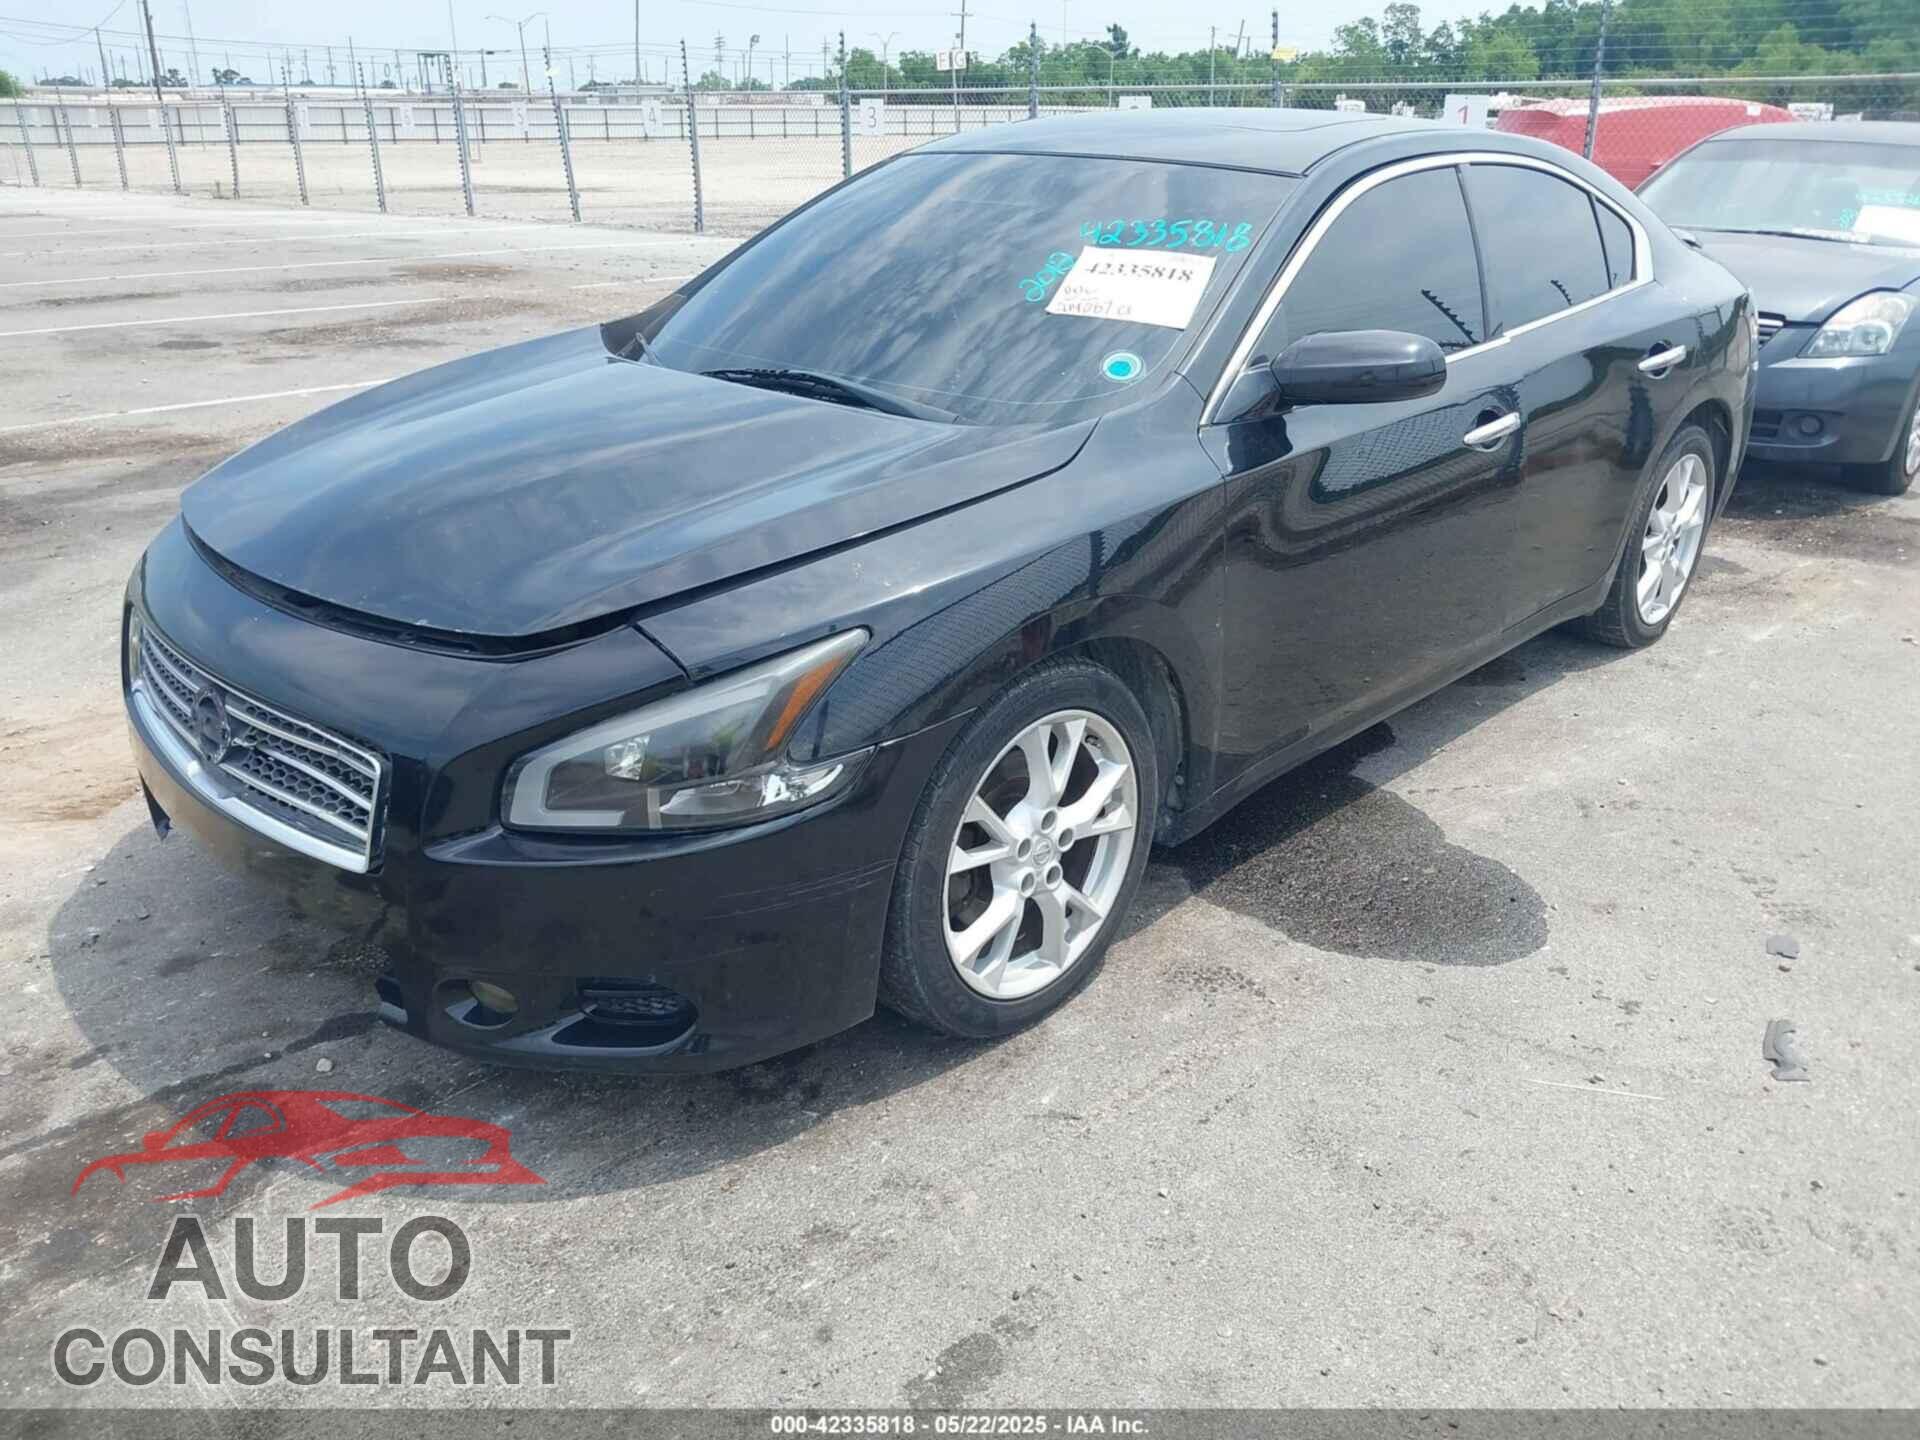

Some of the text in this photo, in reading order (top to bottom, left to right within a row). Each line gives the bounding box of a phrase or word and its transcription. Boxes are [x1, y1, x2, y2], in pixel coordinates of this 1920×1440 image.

[647, 105, 657, 125] 4
[866, 106, 878, 128] 3
[1456, 104, 1470, 125] 1
[1079, 218, 1254, 253] 42335818
[1085, 261, 1195, 282] 42335818
